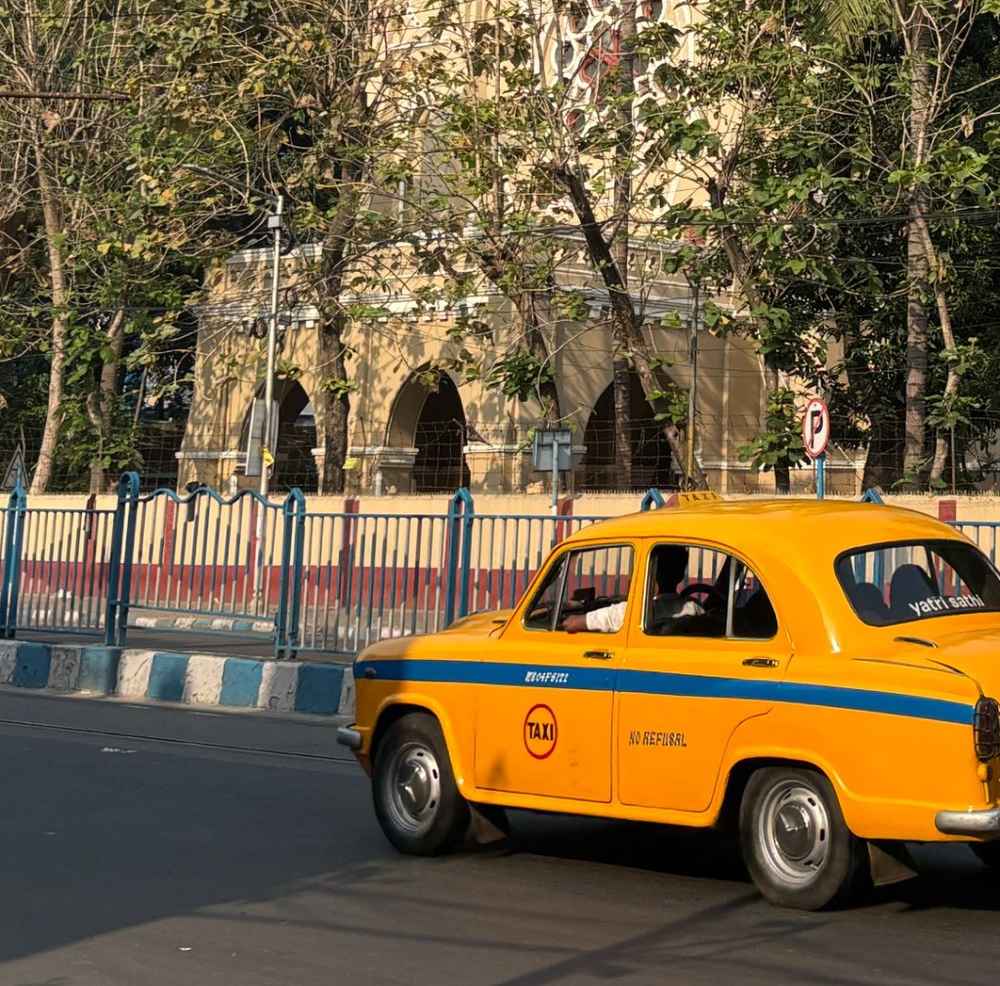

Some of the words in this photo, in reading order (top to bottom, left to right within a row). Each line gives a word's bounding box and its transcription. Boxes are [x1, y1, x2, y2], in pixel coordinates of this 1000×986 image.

[681, 492, 717, 502] TAXI
[908, 596, 950, 617] yatri
[948, 594, 985, 608] sathi
[527, 722, 554, 740] TAXI
[629, 730, 641, 745] NO
